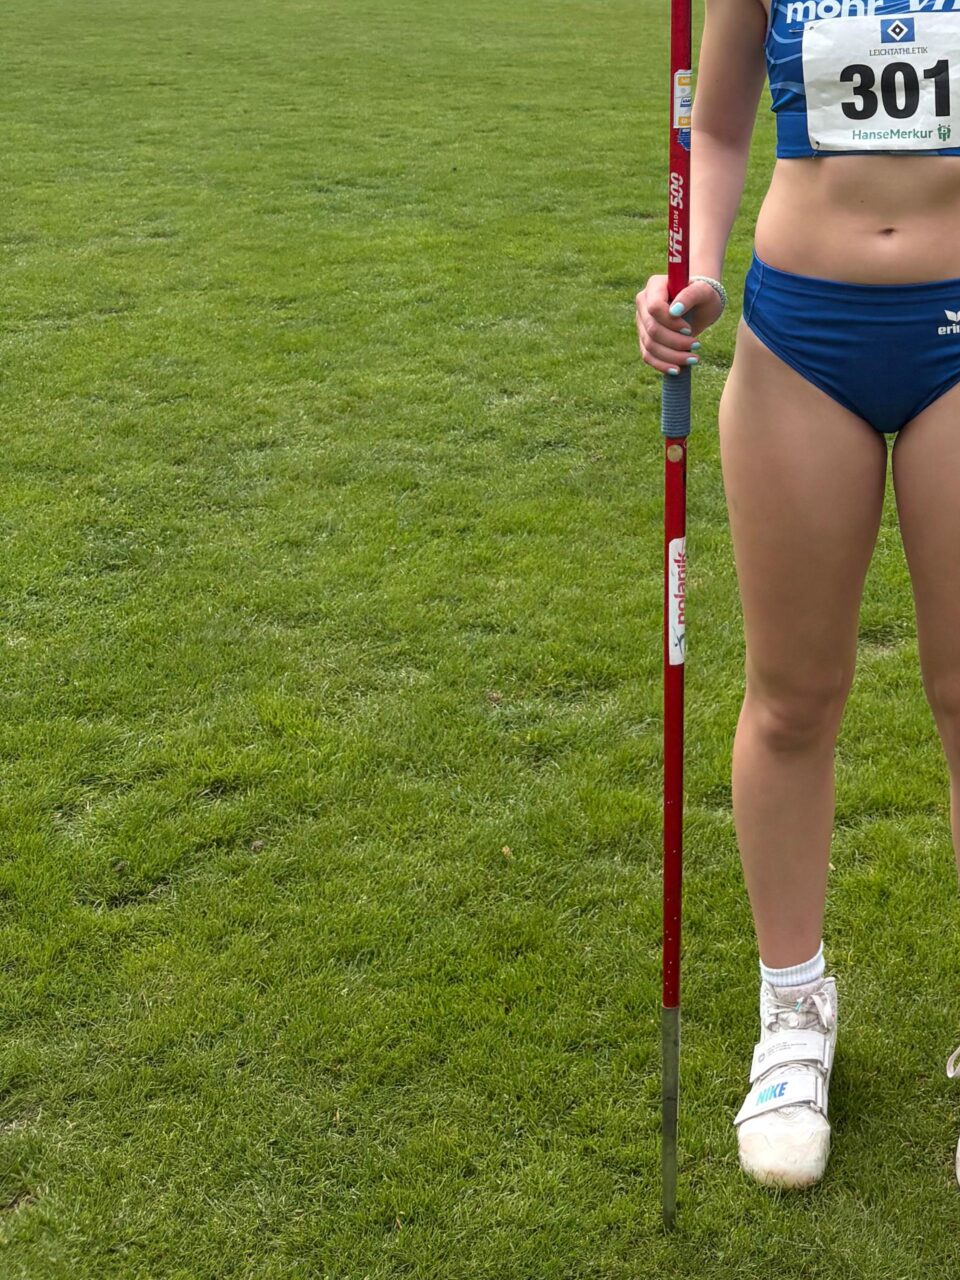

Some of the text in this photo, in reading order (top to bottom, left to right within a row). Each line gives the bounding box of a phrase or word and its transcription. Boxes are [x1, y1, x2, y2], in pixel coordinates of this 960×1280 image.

[869, 46, 929, 57] LEICHTATHLETIK
[839, 59, 951, 121] 301
[852, 128, 934, 141] HanseMerkur
[670, 171, 684, 210] 500
[756, 1081, 788, 1106] NIKE
